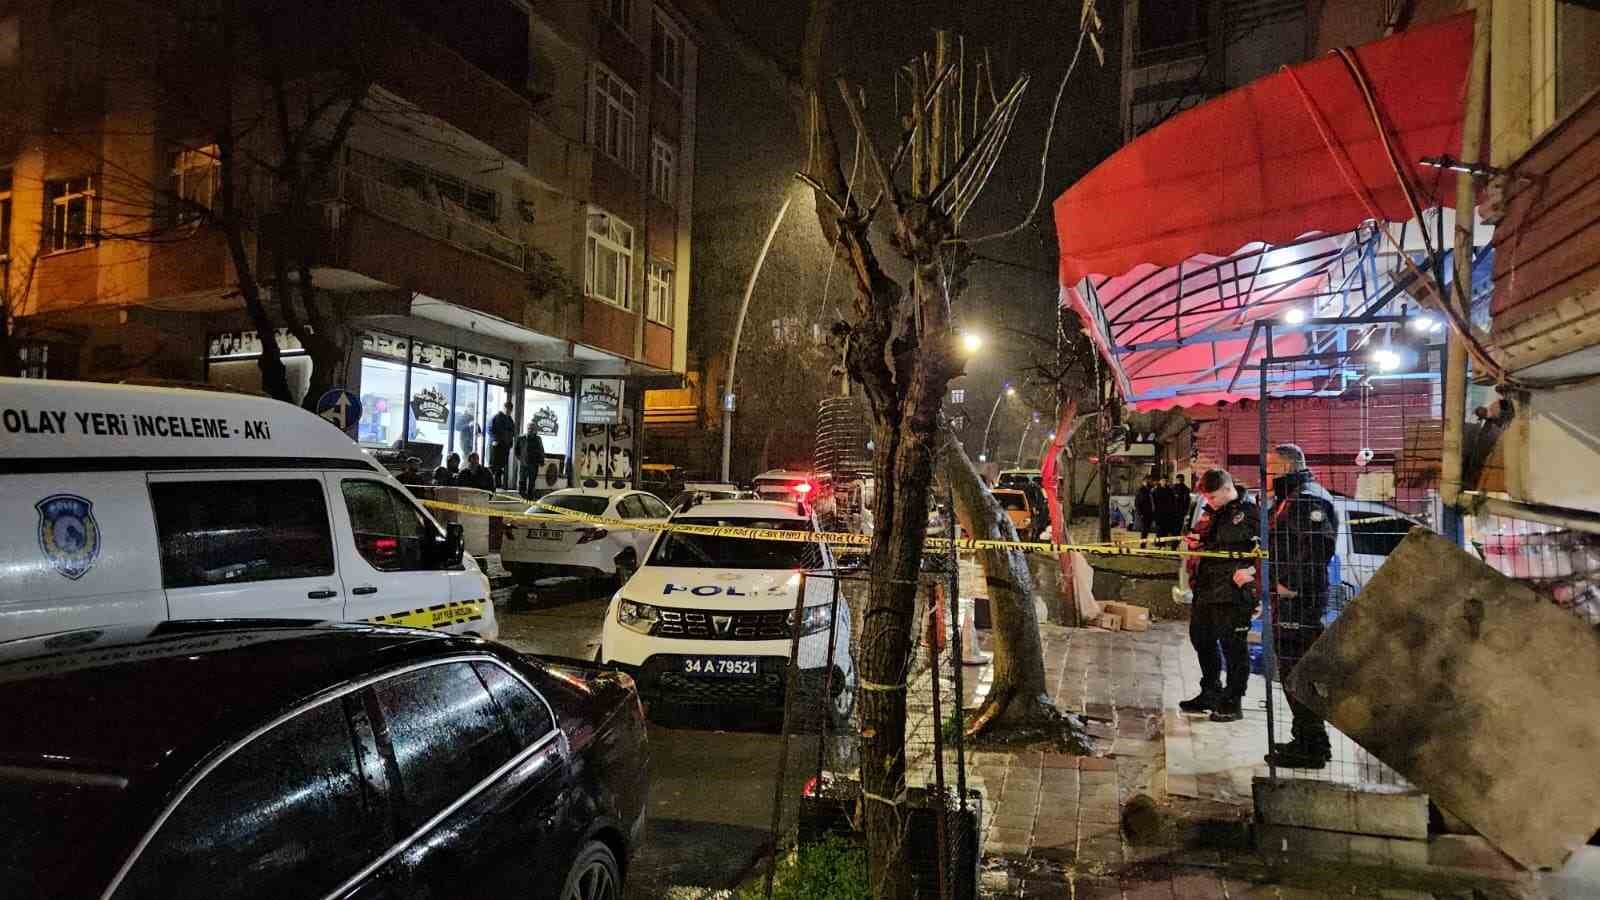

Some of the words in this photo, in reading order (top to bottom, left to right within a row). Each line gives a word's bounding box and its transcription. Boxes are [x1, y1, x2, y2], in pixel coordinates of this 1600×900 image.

[2, 408, 66, 434] OLAY
[663, 583, 787, 598] POL
[685, 659, 701, 673] 34
[703, 660, 715, 673] A
[718, 660, 757, 674] 79521
